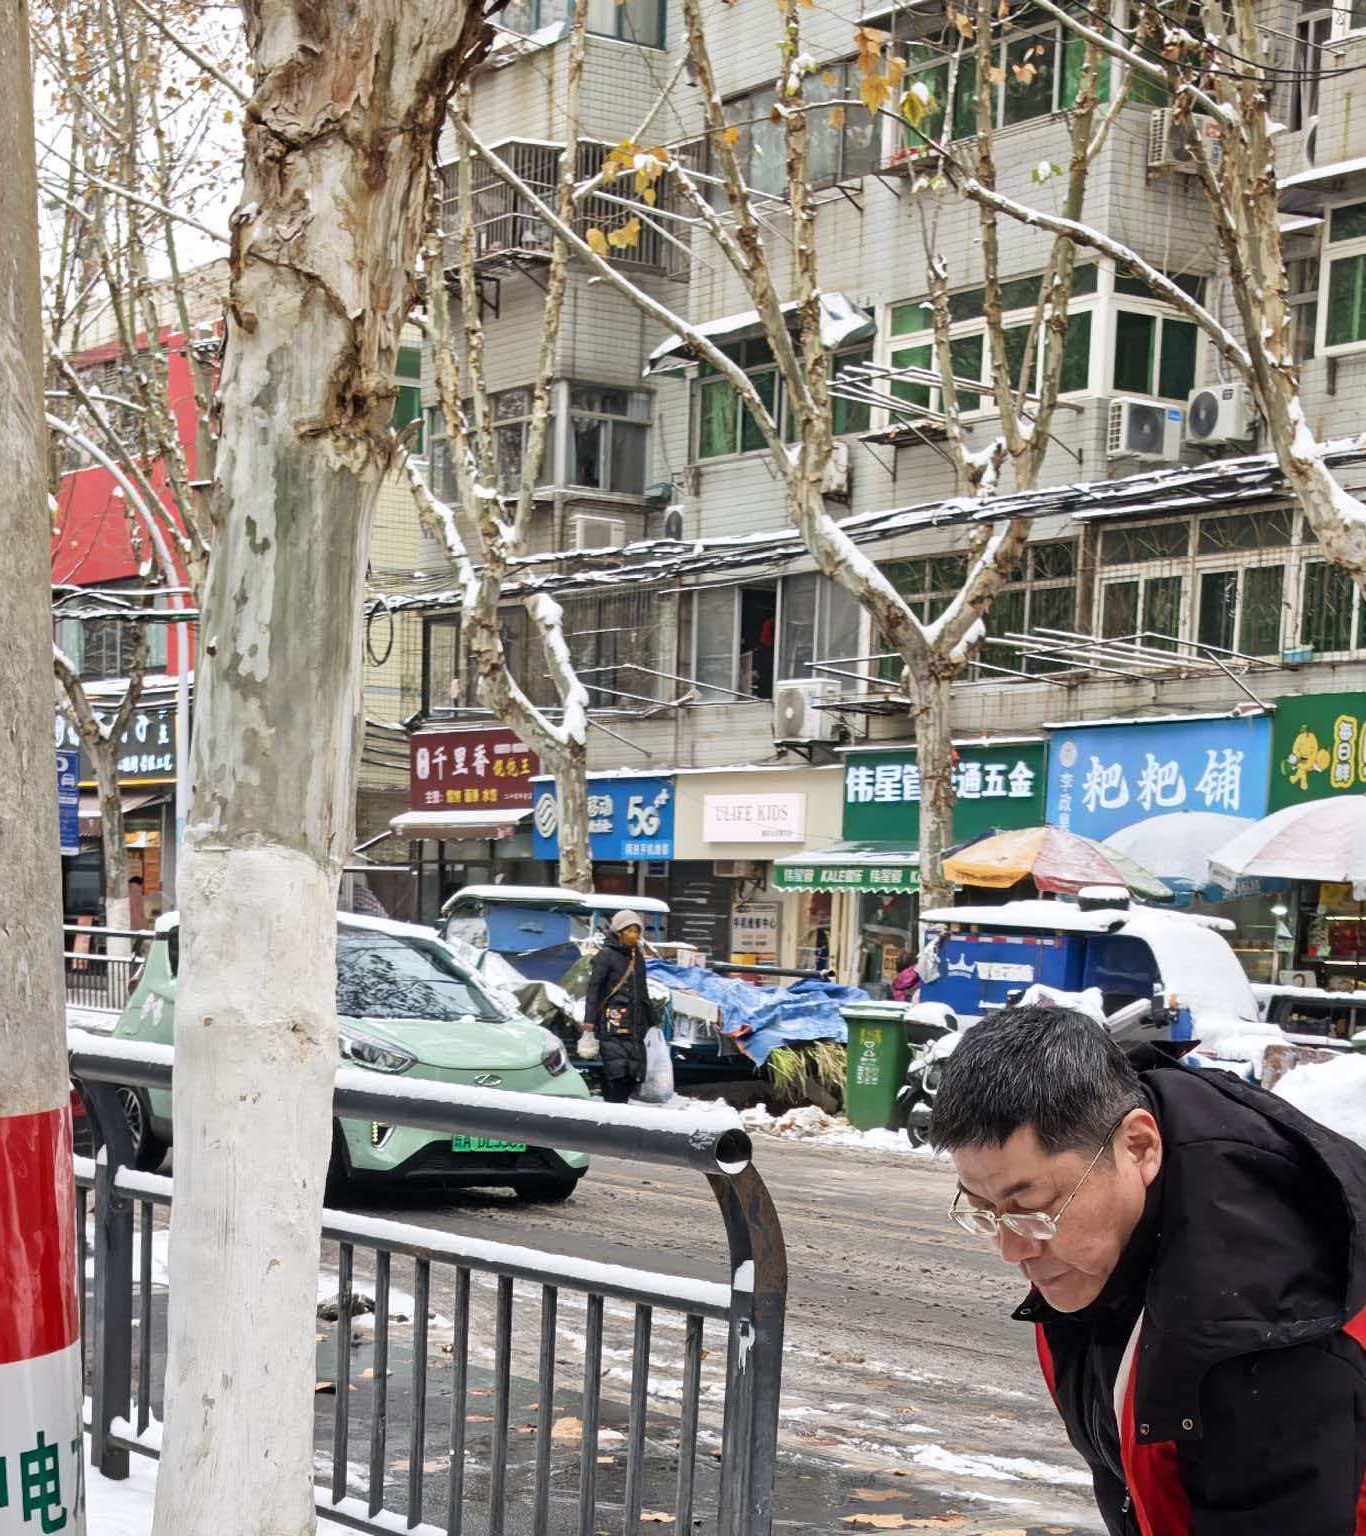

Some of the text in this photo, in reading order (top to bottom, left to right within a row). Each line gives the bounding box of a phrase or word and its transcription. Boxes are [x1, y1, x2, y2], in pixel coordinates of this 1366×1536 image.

[432, 744, 490, 780] 千里香
[1082, 748, 1244, 813] 粑粑铺
[846, 761, 1035, 803] 伟星管通五金
[757, 804, 788, 821] KIDS
